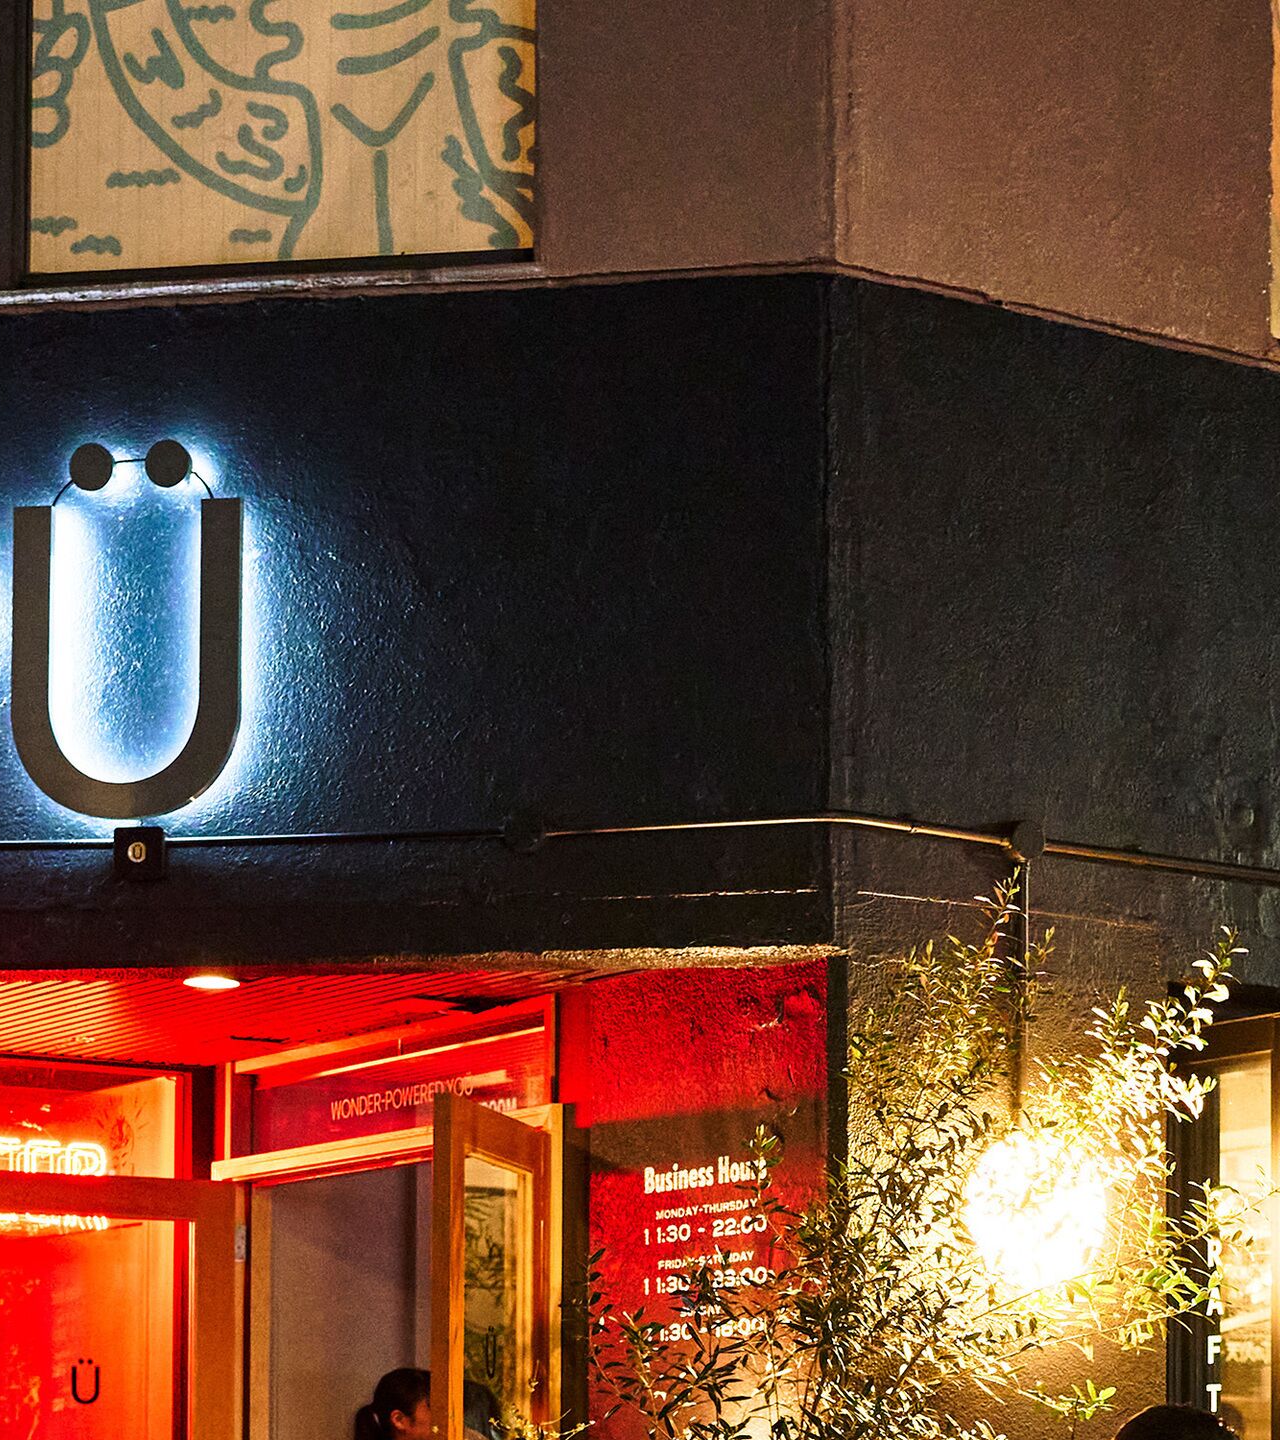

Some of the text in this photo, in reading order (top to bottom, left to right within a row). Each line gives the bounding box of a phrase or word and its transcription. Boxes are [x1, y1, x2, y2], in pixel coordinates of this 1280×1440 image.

[643, 1163, 715, 1194] Business
[655, 1198, 758, 1220] MONDAY-THURSDAY
[712, 1214, 768, 1238] 22:00
[71, 1358, 100, 1404] Ü
